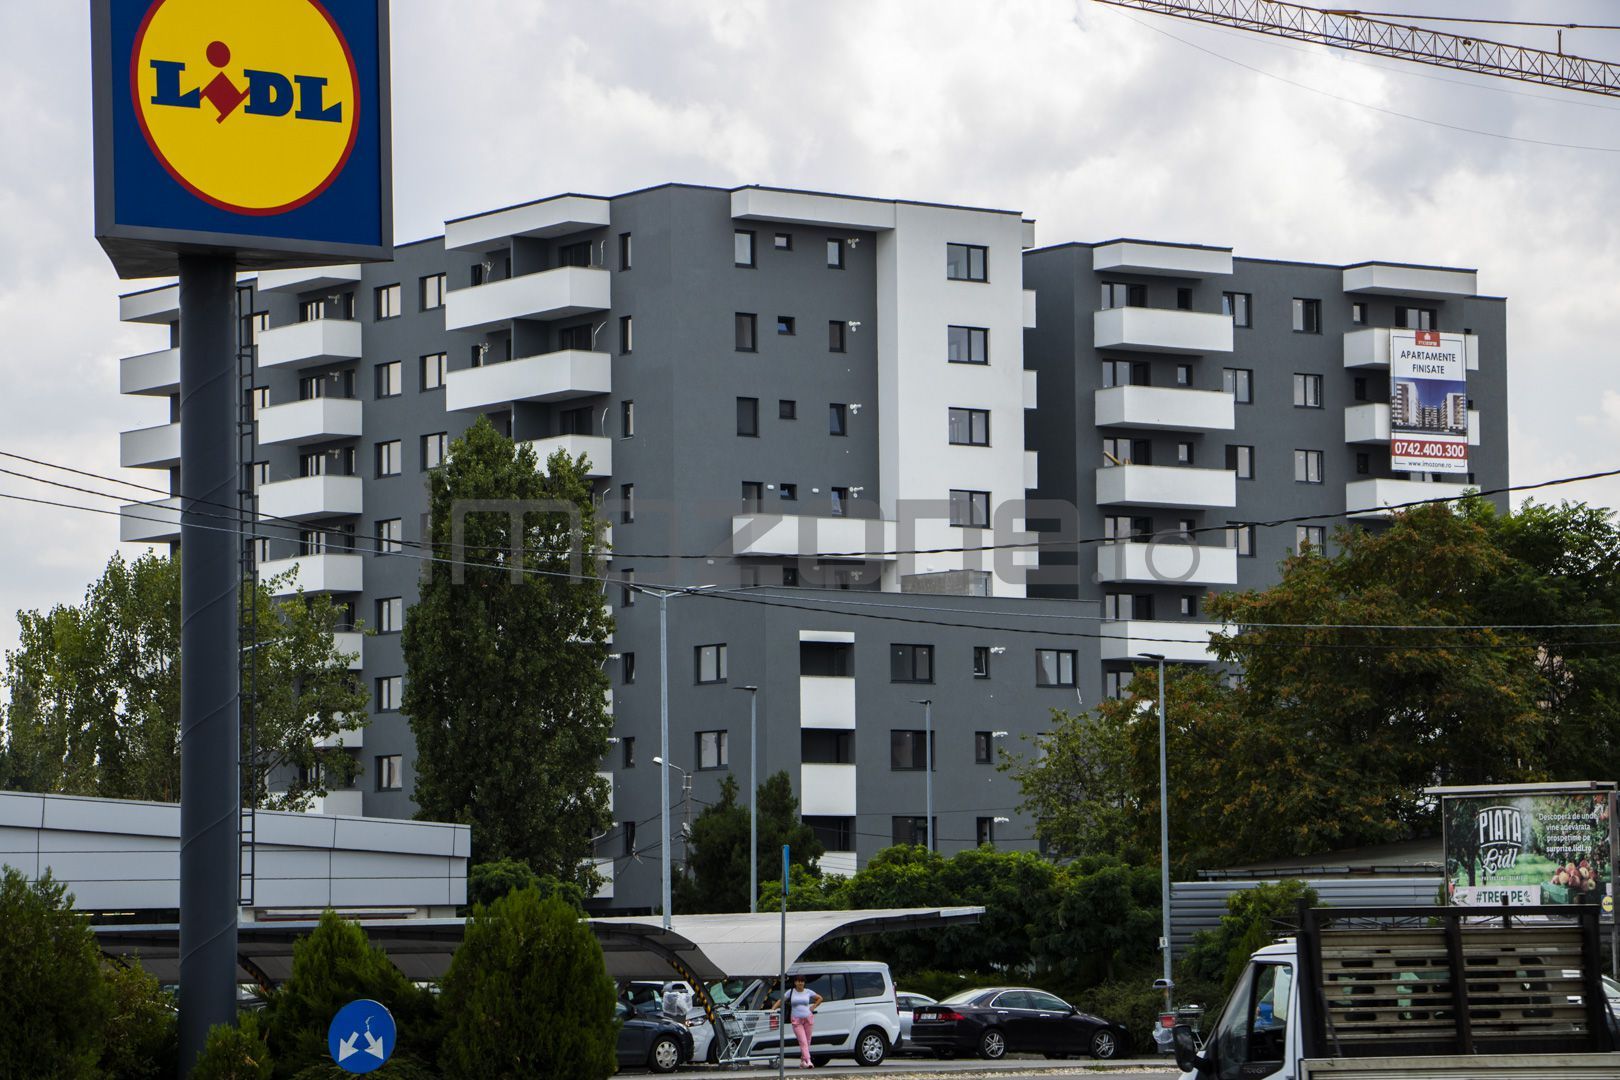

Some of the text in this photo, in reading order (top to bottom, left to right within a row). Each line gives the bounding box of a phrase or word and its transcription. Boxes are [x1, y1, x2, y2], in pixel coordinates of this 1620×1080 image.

[1400, 350, 1456, 362] APARTAMENTE
[1412, 363, 1445, 374] FINISATE
[1394, 442, 1464, 457] 0742.400.300
[1483, 848, 1518, 874] Lidl
